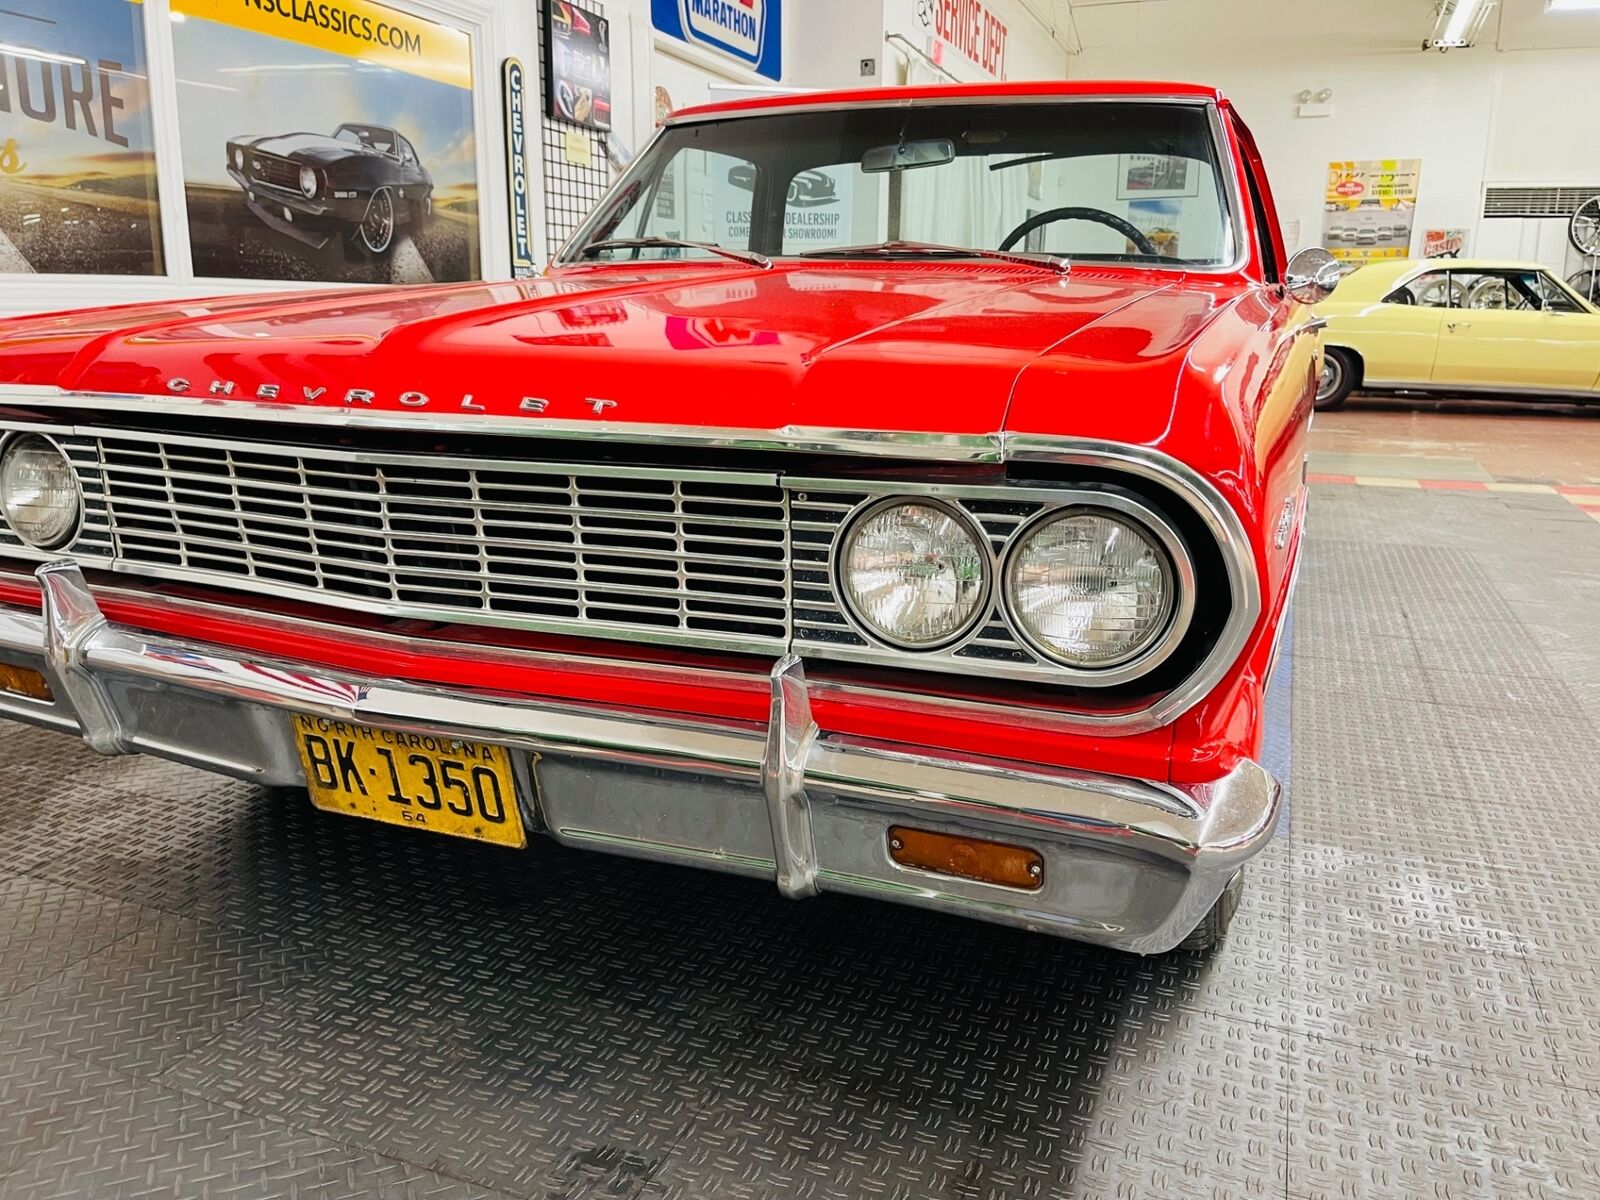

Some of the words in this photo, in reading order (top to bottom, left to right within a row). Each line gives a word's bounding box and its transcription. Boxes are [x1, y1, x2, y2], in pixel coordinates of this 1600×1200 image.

[692, 0, 756, 41] MARATHON
[935, 0, 981, 63] SERVICE
[510, 70, 528, 256] CHEVROLET
[786, 211, 840, 226] DEALERSHIP
[788, 227, 837, 239] SHOWROOM!
[166, 376, 618, 415] CHEVROLET
[301, 716, 375, 741] NORTH
